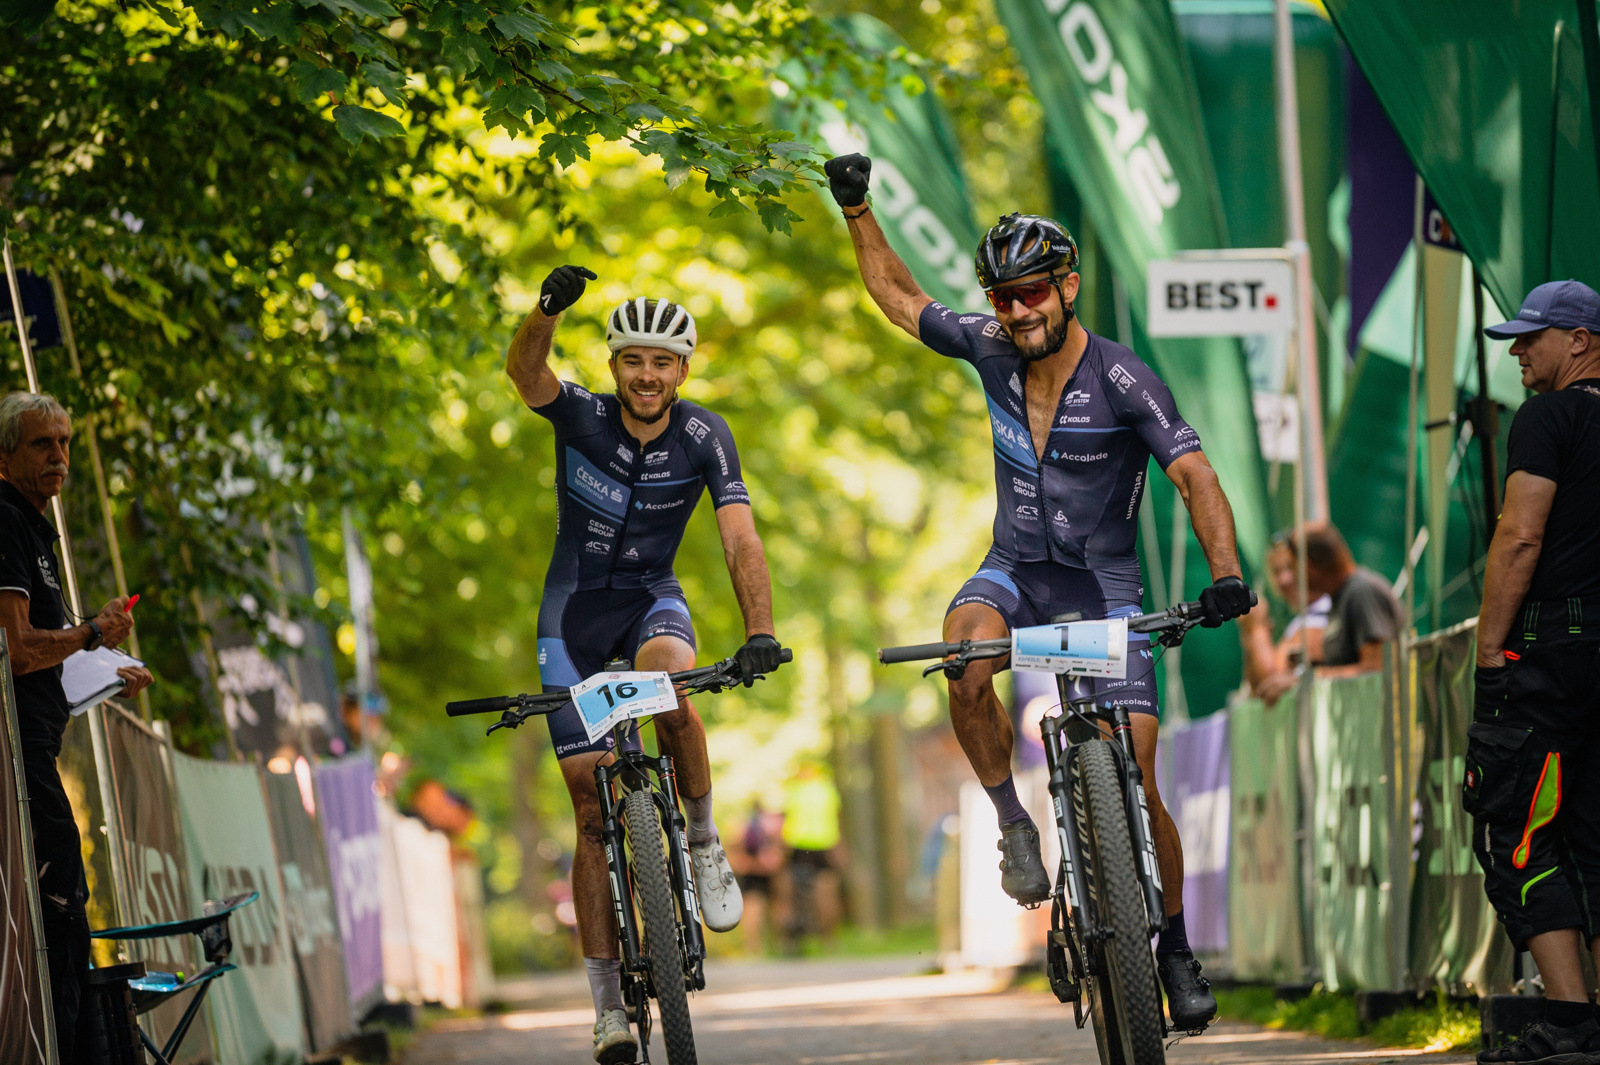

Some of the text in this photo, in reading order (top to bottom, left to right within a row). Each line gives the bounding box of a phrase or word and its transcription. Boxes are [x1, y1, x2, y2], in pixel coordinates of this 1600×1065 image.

[1166, 281, 1278, 310] BEST.
[1060, 451, 1108, 463] Accolade
[576, 465, 609, 497] ČESKÁ
[1012, 477, 1036, 492] CENTR
[1013, 485, 1037, 498] GROUP
[644, 499, 685, 510] Accolade
[587, 525, 615, 538] GROUP
[589, 519, 616, 533] CENTR
[1054, 626, 1069, 651] 1
[596, 682, 639, 709] 16
[1112, 698, 1152, 707] Accolade
